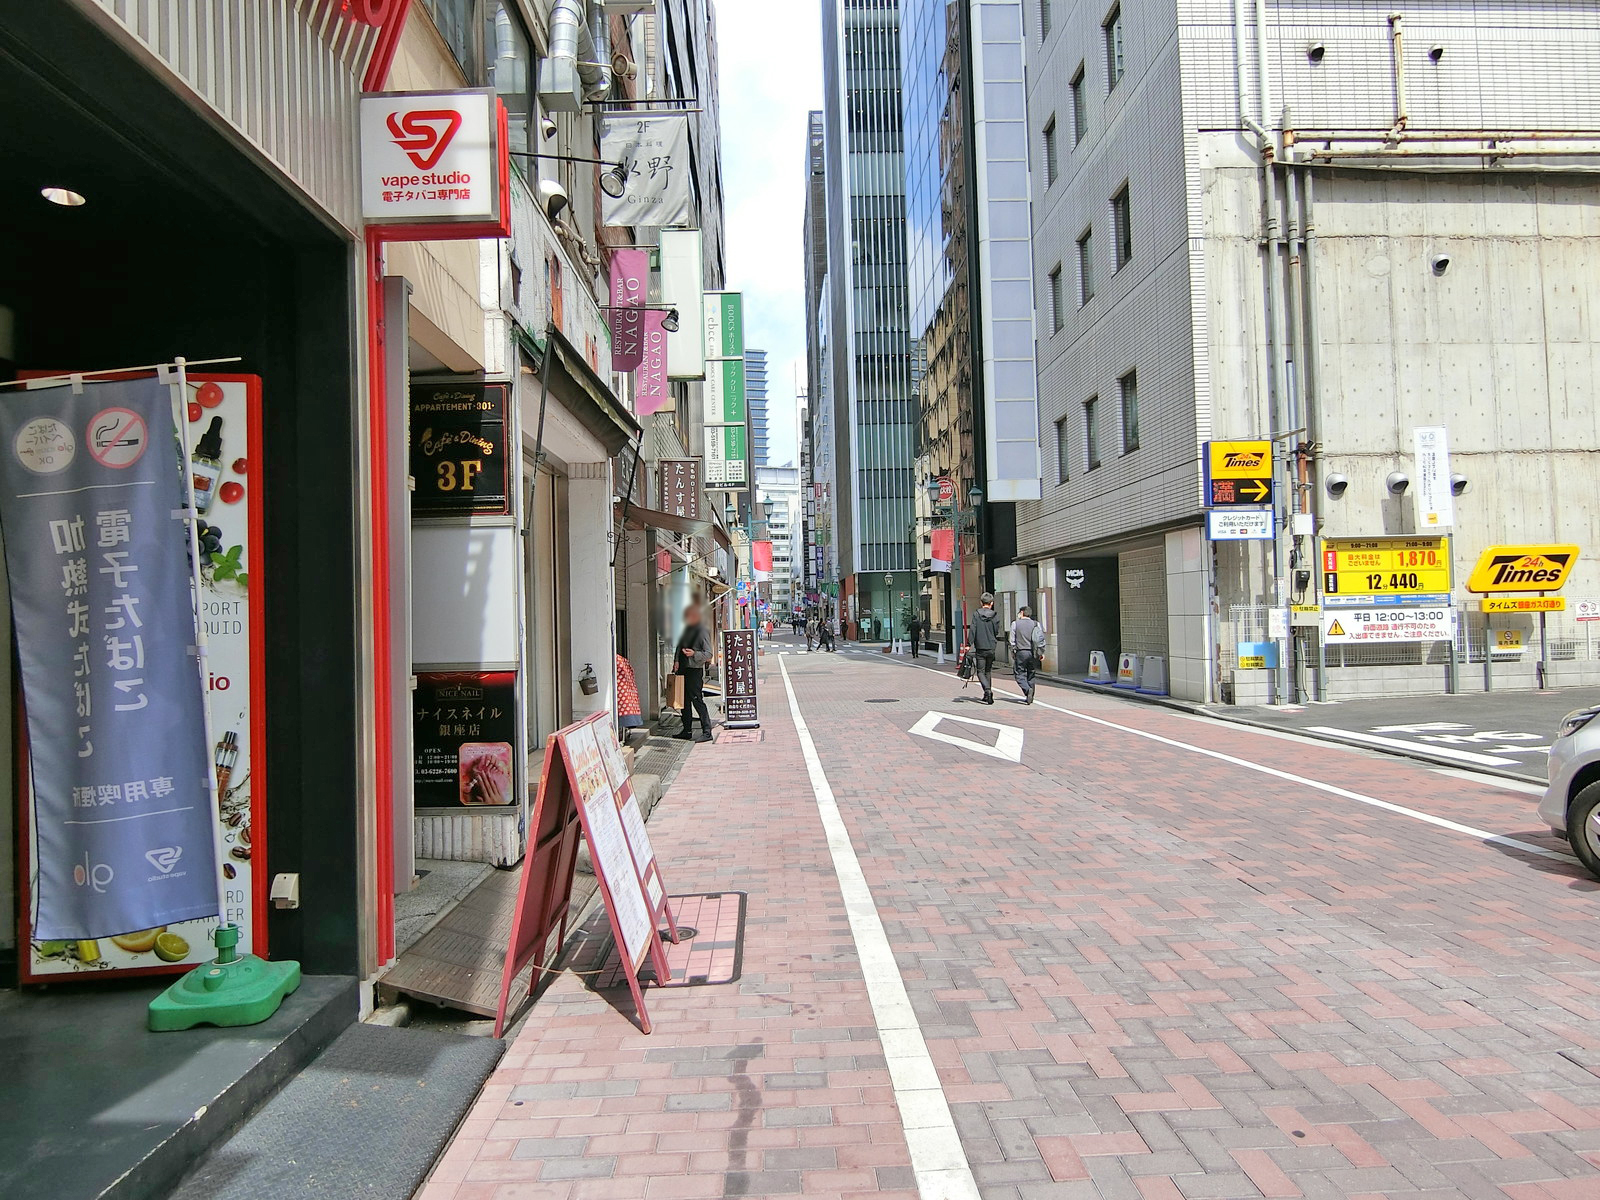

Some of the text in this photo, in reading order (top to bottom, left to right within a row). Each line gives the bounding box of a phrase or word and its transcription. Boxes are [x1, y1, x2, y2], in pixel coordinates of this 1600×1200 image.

[637, 121, 650, 133] 2F
[381, 171, 470, 188] vape studio
[382, 189, 471, 202] 電子タバコ専門店
[627, 195, 664, 204] Ginza
[624, 277, 640, 356] NAGAO
[650, 331, 662, 397] NAGAO
[414, 402, 472, 412] APPARTEMENT
[1223, 453, 1264, 468] Times
[437, 461, 482, 491] 3F
[675, 463, 685, 518] たんす屋
[1066, 569, 1084, 577] MCM
[1488, 554, 1570, 585] Times
[1354, 612, 1371, 622] 平日
[1391, 622, 1436, 630] 通行不可のため
[733, 634, 746, 694] たんす屋
[417, 706, 503, 720] ナイスネイル
[440, 723, 480, 736] 銀座店
